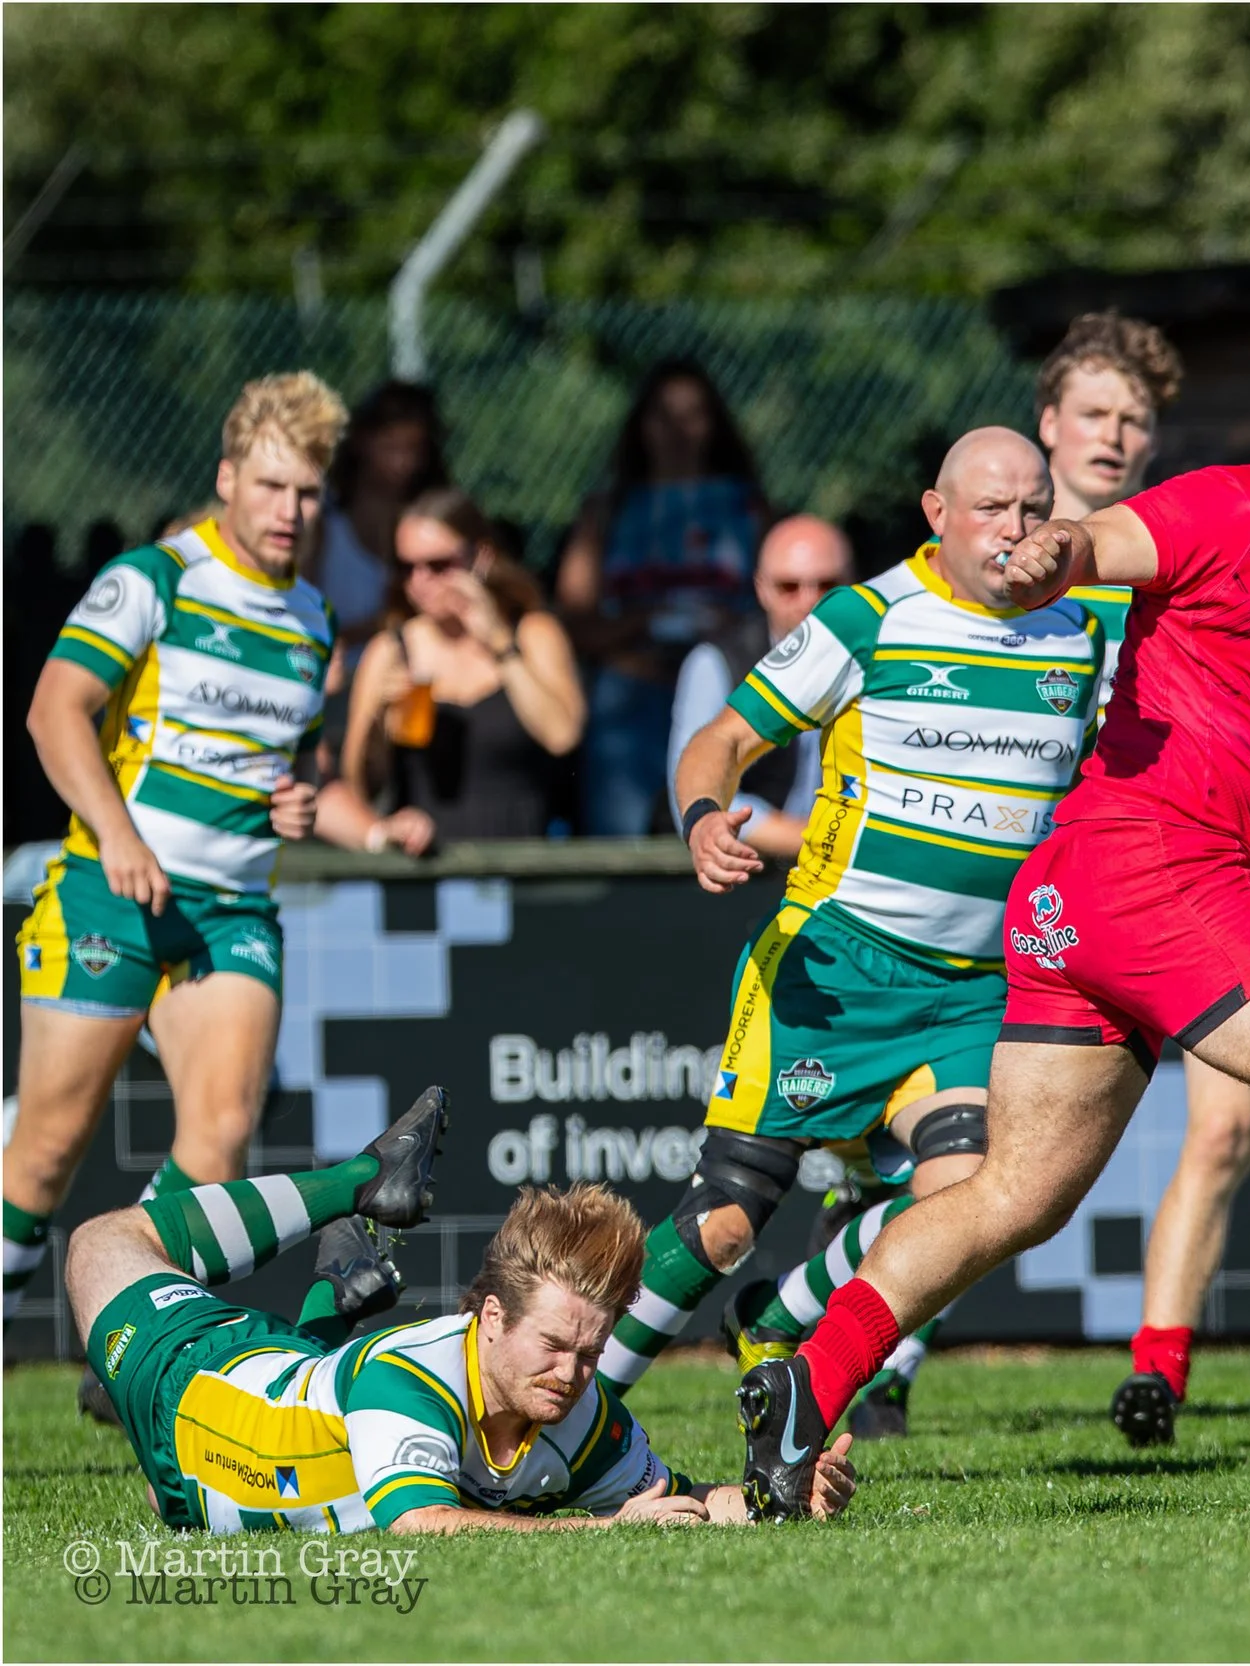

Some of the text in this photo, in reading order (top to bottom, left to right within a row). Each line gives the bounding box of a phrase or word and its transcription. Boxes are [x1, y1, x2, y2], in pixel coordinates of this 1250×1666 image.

[906, 687, 970, 700] GILBERT
[1041, 686, 1079, 699] RAIDERS
[902, 788, 1053, 835] PRAXIS
[782, 1079, 828, 1095] RAIDERS
[487, 1113, 559, 1186] of
[108, 1328, 132, 1371] RAIDERS
